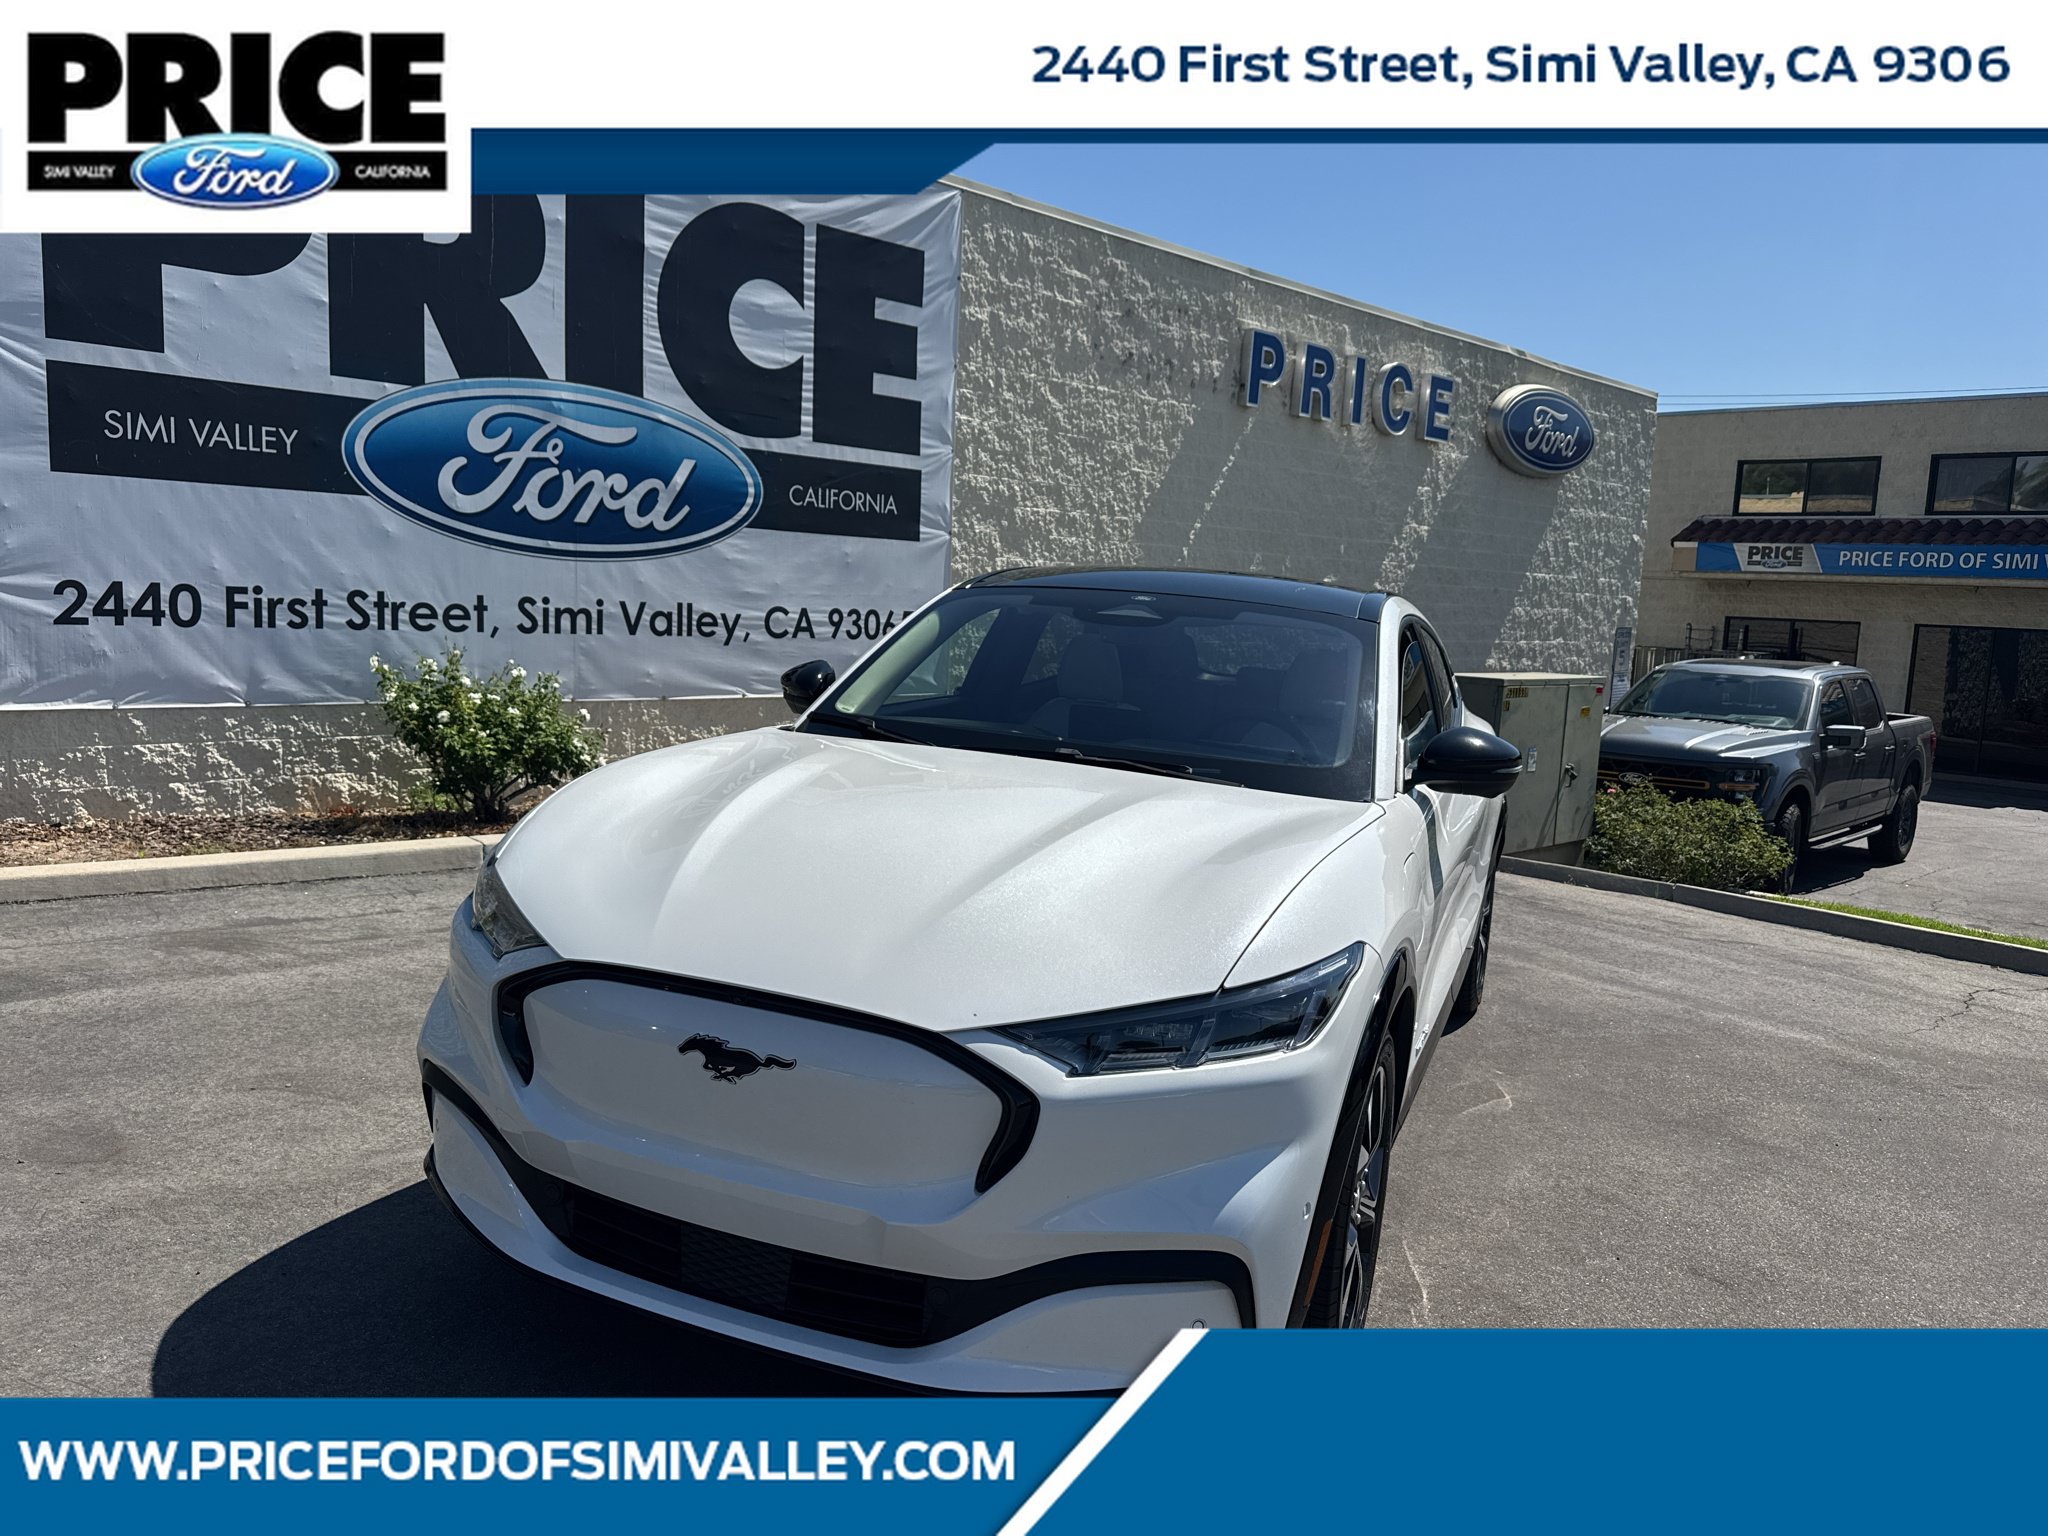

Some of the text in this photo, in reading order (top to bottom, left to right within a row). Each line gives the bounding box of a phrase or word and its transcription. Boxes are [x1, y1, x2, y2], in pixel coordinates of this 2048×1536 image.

[1244, 327, 1456, 443] PRICE
[103, 409, 299, 455] SIMI VALLEY
[1524, 405, 1580, 458] Ford
[437, 404, 697, 532] Ford
[788, 484, 898, 516] CALIFORNIA
[1747, 545, 1805, 561] PRICE
[1839, 551, 1893, 567] PRICE
[1898, 551, 1954, 568] FORD
[1959, 552, 1987, 569] OF
[1992, 553, 2039, 570] SIMI
[53, 579, 202, 628] 2440
[225, 585, 329, 630] First
[345, 589, 499, 639] Street,
[516, 596, 604, 635] Simi
[619, 600, 750, 647] Valley,
[764, 606, 816, 639] CA
